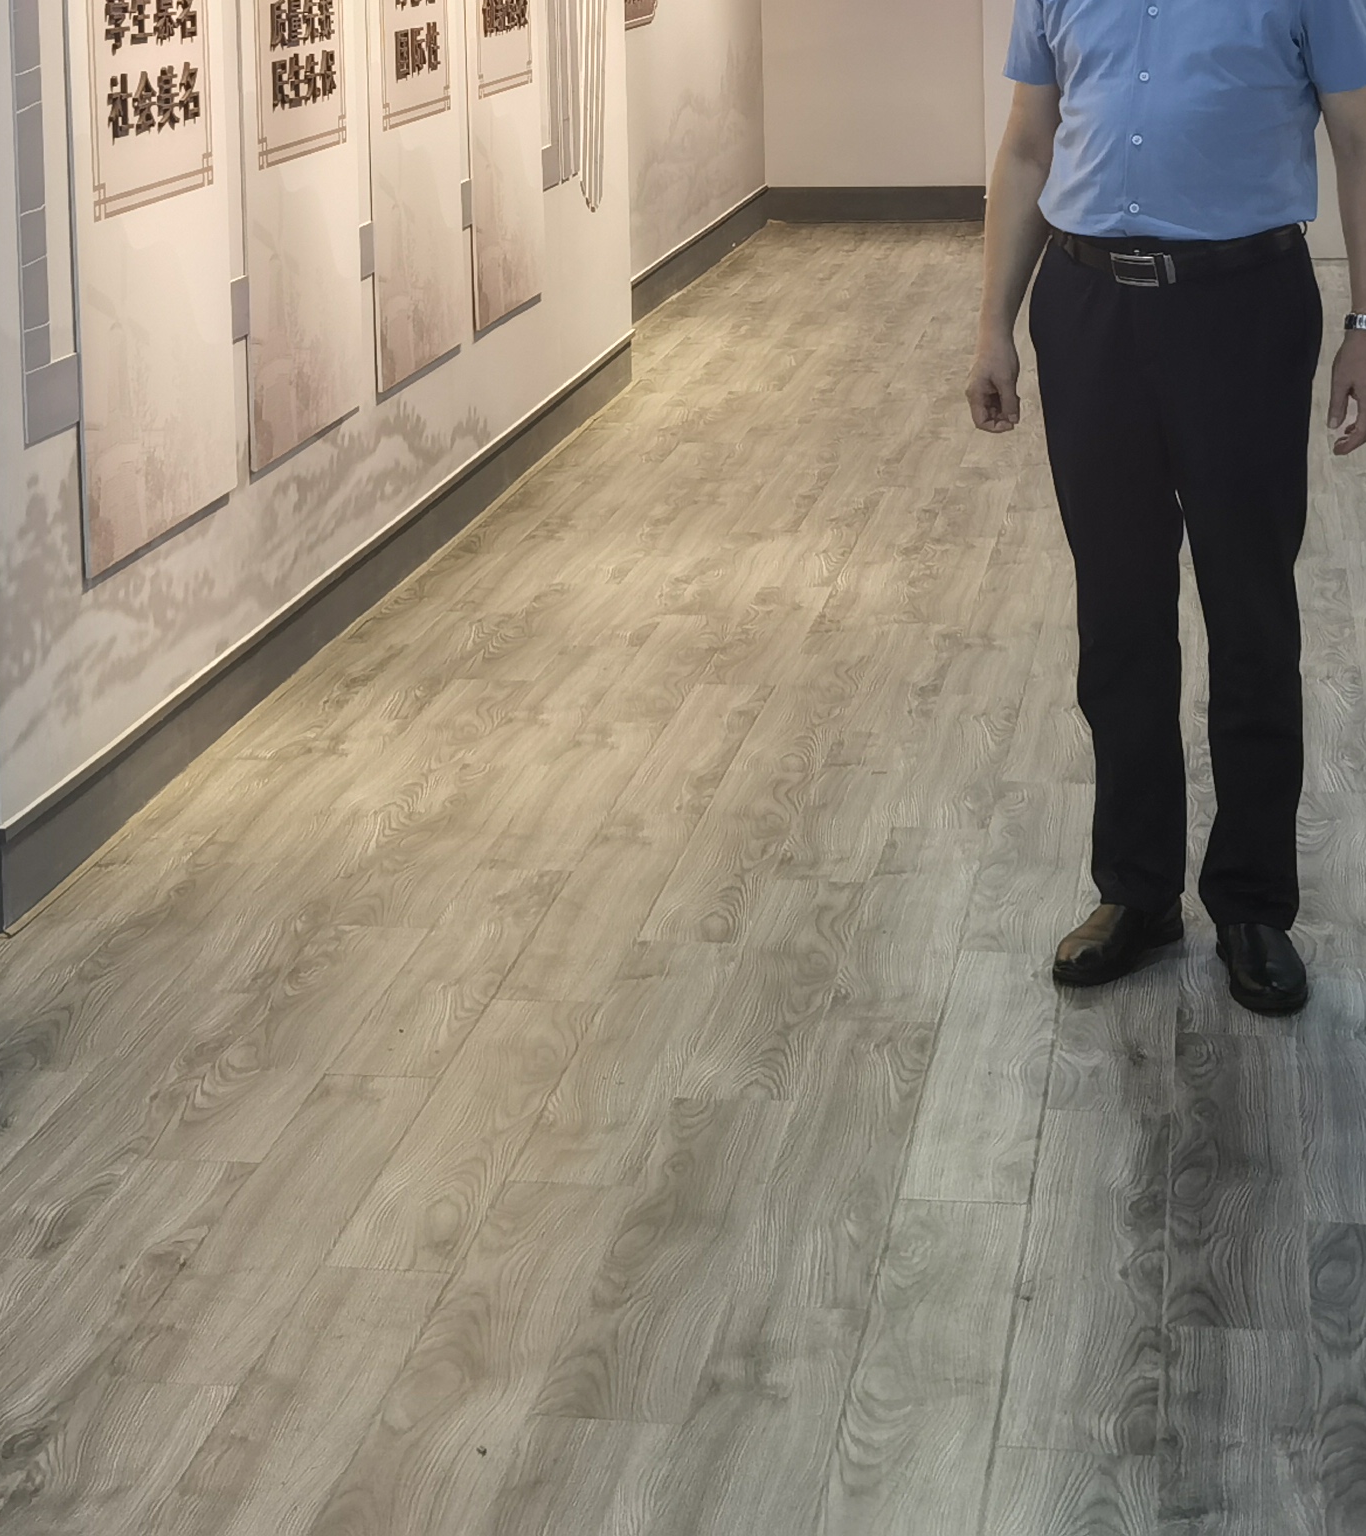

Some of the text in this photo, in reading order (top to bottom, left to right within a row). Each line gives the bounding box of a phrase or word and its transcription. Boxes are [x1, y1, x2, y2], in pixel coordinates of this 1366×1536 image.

[271, 50, 336, 114] 民生先保
[394, 21, 441, 84] 国际性
[107, 61, 200, 146] 社会美名
